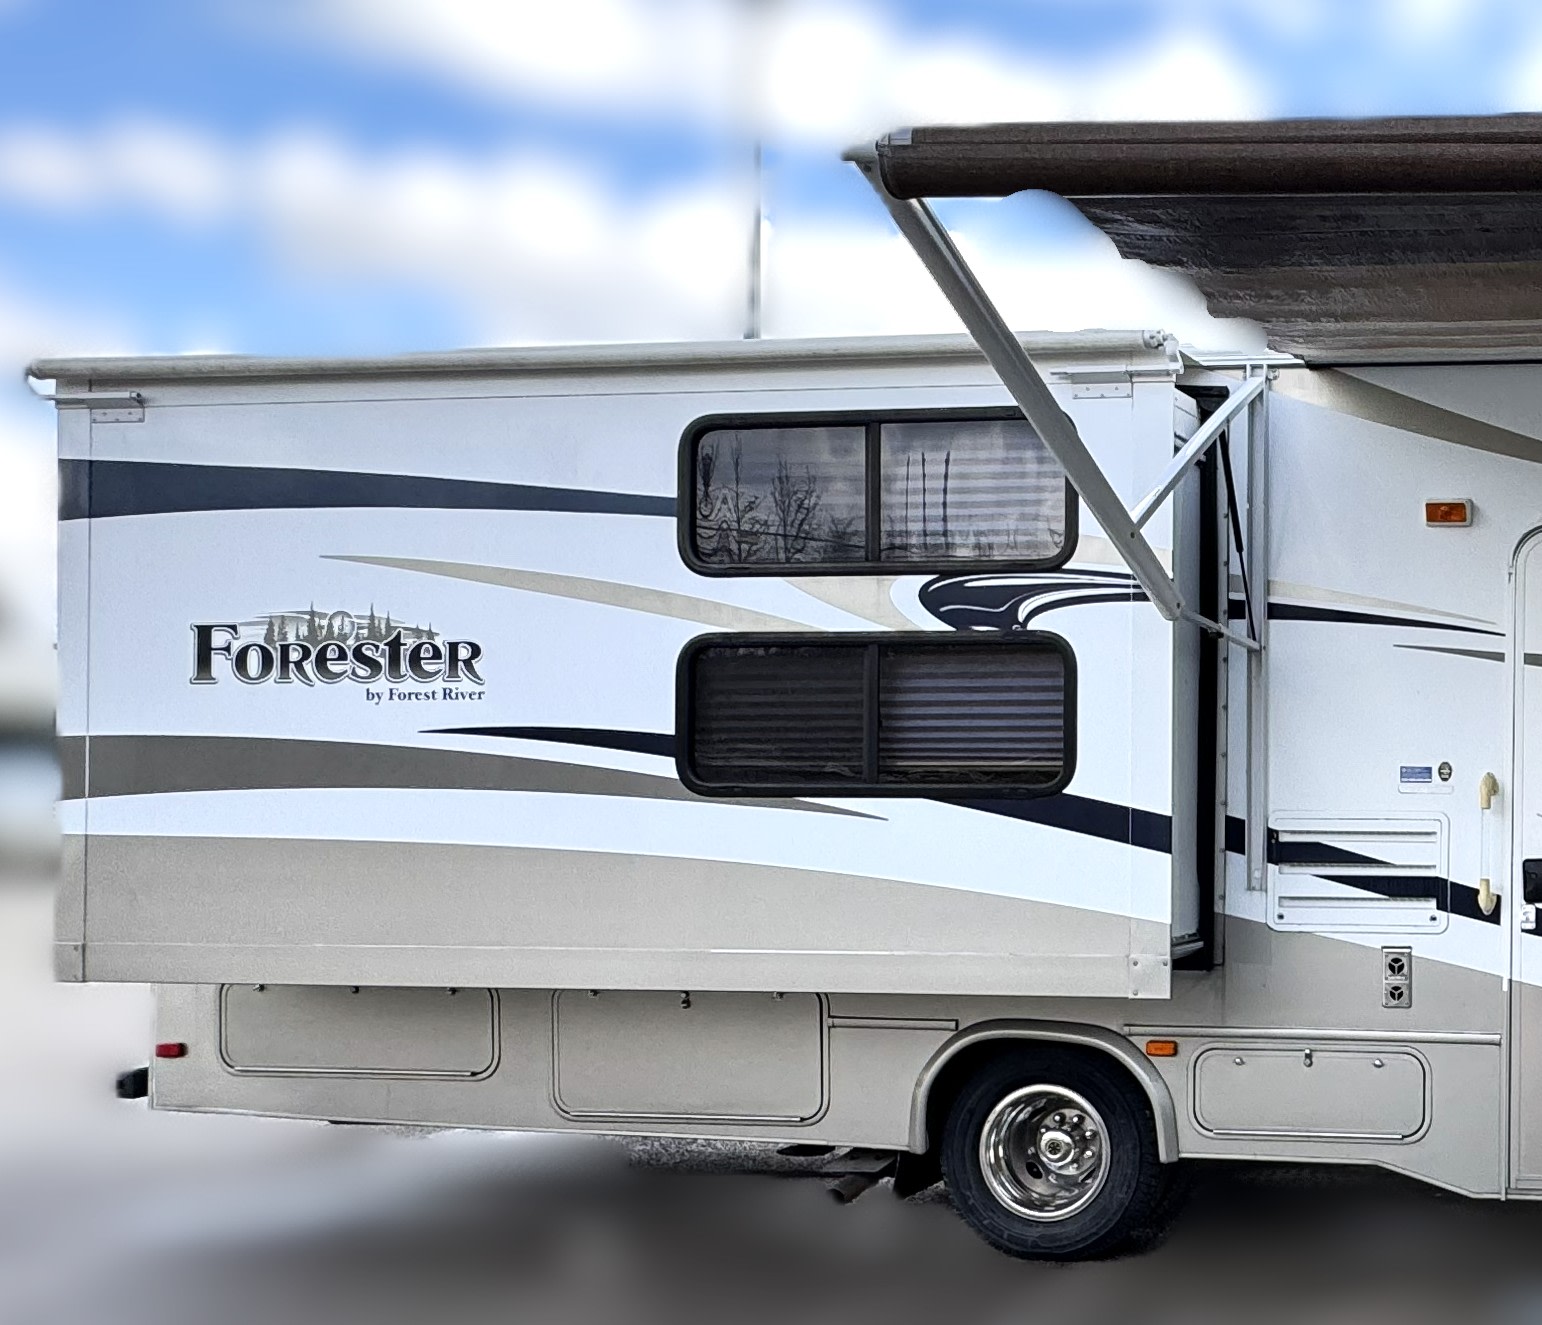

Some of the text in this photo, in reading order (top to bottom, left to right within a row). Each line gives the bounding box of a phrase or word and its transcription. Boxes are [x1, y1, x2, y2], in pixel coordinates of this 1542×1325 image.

[365, 686, 486, 705] by Forest River
